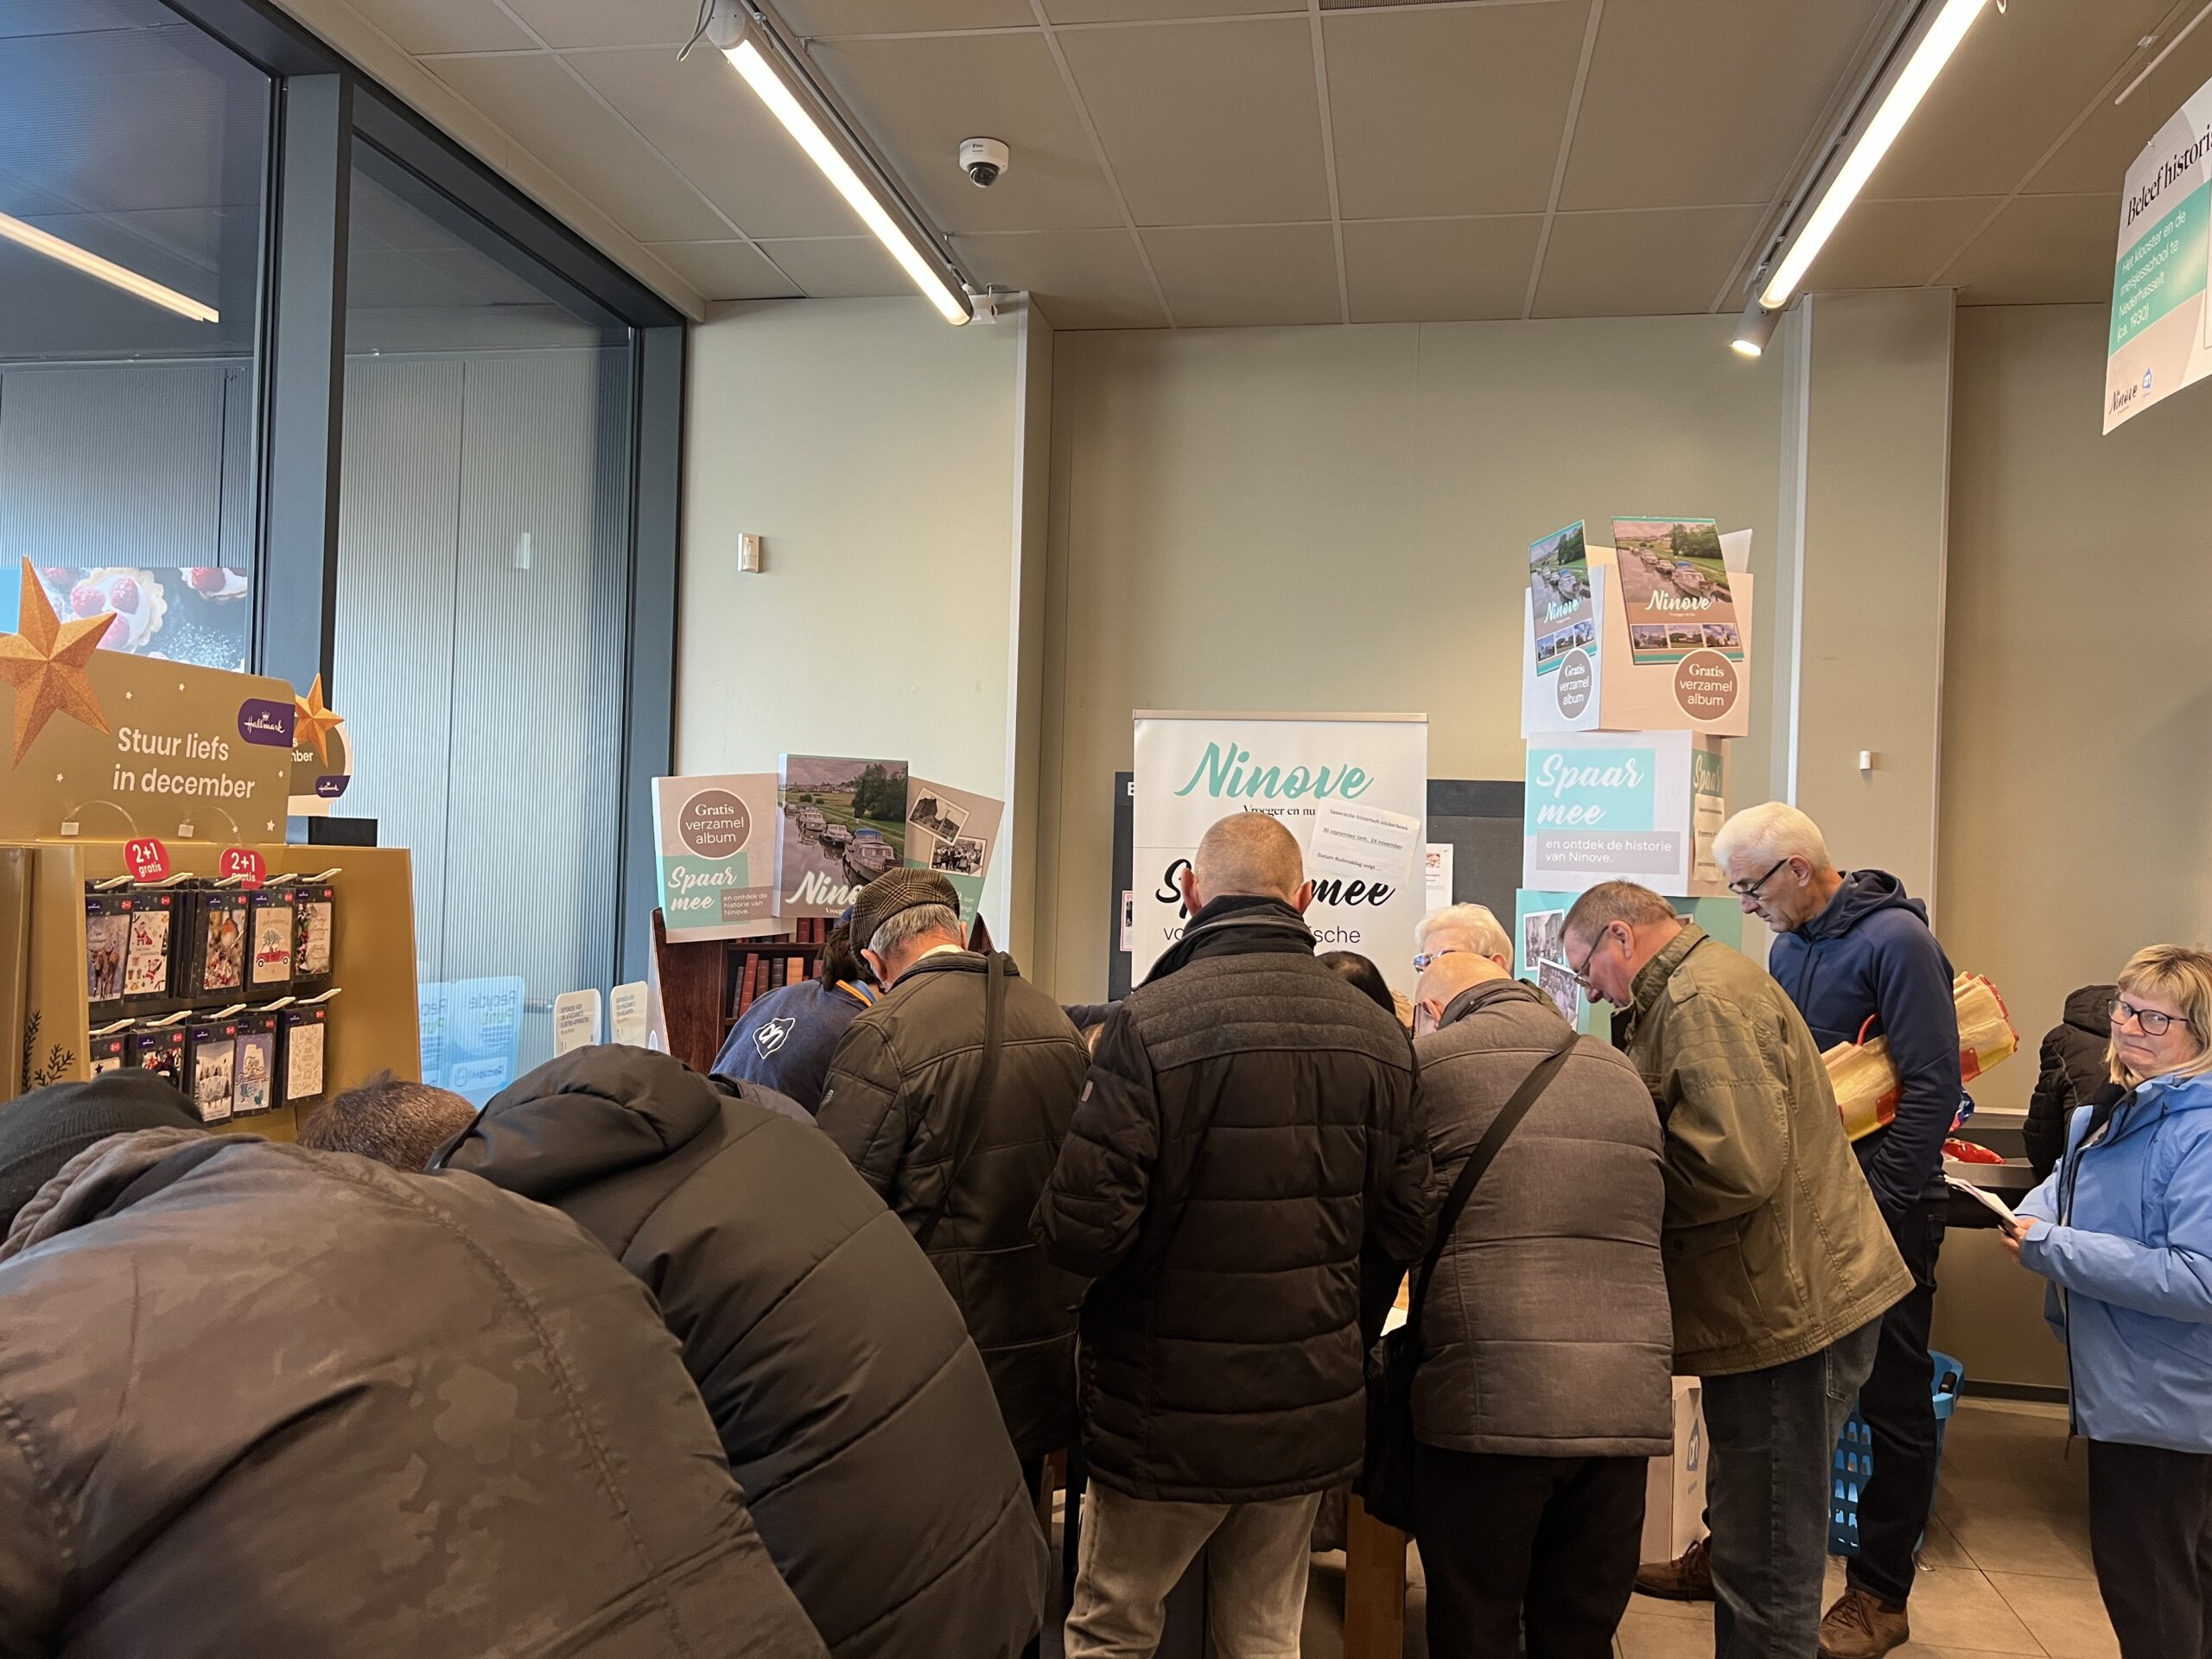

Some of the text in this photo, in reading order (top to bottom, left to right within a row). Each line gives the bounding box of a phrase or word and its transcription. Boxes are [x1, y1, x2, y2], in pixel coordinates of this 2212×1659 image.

[2126, 166, 2164, 227] Beleef
[2122, 210, 2186, 275] Het klooster en de
[2170, 239, 2178, 254] te
[1644, 589, 1713, 611] Ninove
[1543, 598, 1580, 623] Ninove
[1565, 663, 1585, 677] Gratis
[1689, 664, 1725, 677] Gratis
[1559, 676, 1589, 692] verzamel
[1680, 678, 1732, 692] verzamel
[1562, 691, 1584, 705] album
[1688, 692, 1724, 706] album
[244, 714, 285, 734] Hallmark
[118, 727, 229, 761] Stuur liefs
[1173, 741, 1375, 800] Ninove
[1535, 753, 1644, 798] Spaar
[113, 764, 255, 798] in december
[695, 804, 734, 816] Gratis
[1536, 804, 1605, 825] mee
[685, 817, 745, 830] verzamel
[696, 832, 736, 844] album
[1546, 839, 1672, 851] en ontdek de historie
[132, 842, 159, 864] 2+1
[231, 852, 256, 872] 2+1
[1546, 851, 1613, 862] van Ninove.
[138, 861, 162, 878] gratis
[667, 866, 738, 894] Spaar
[785, 870, 864, 905] Nino
[733, 893, 758, 901] ontdek
[1311, 878, 1396, 906] mee
[671, 895, 715, 912] mee
